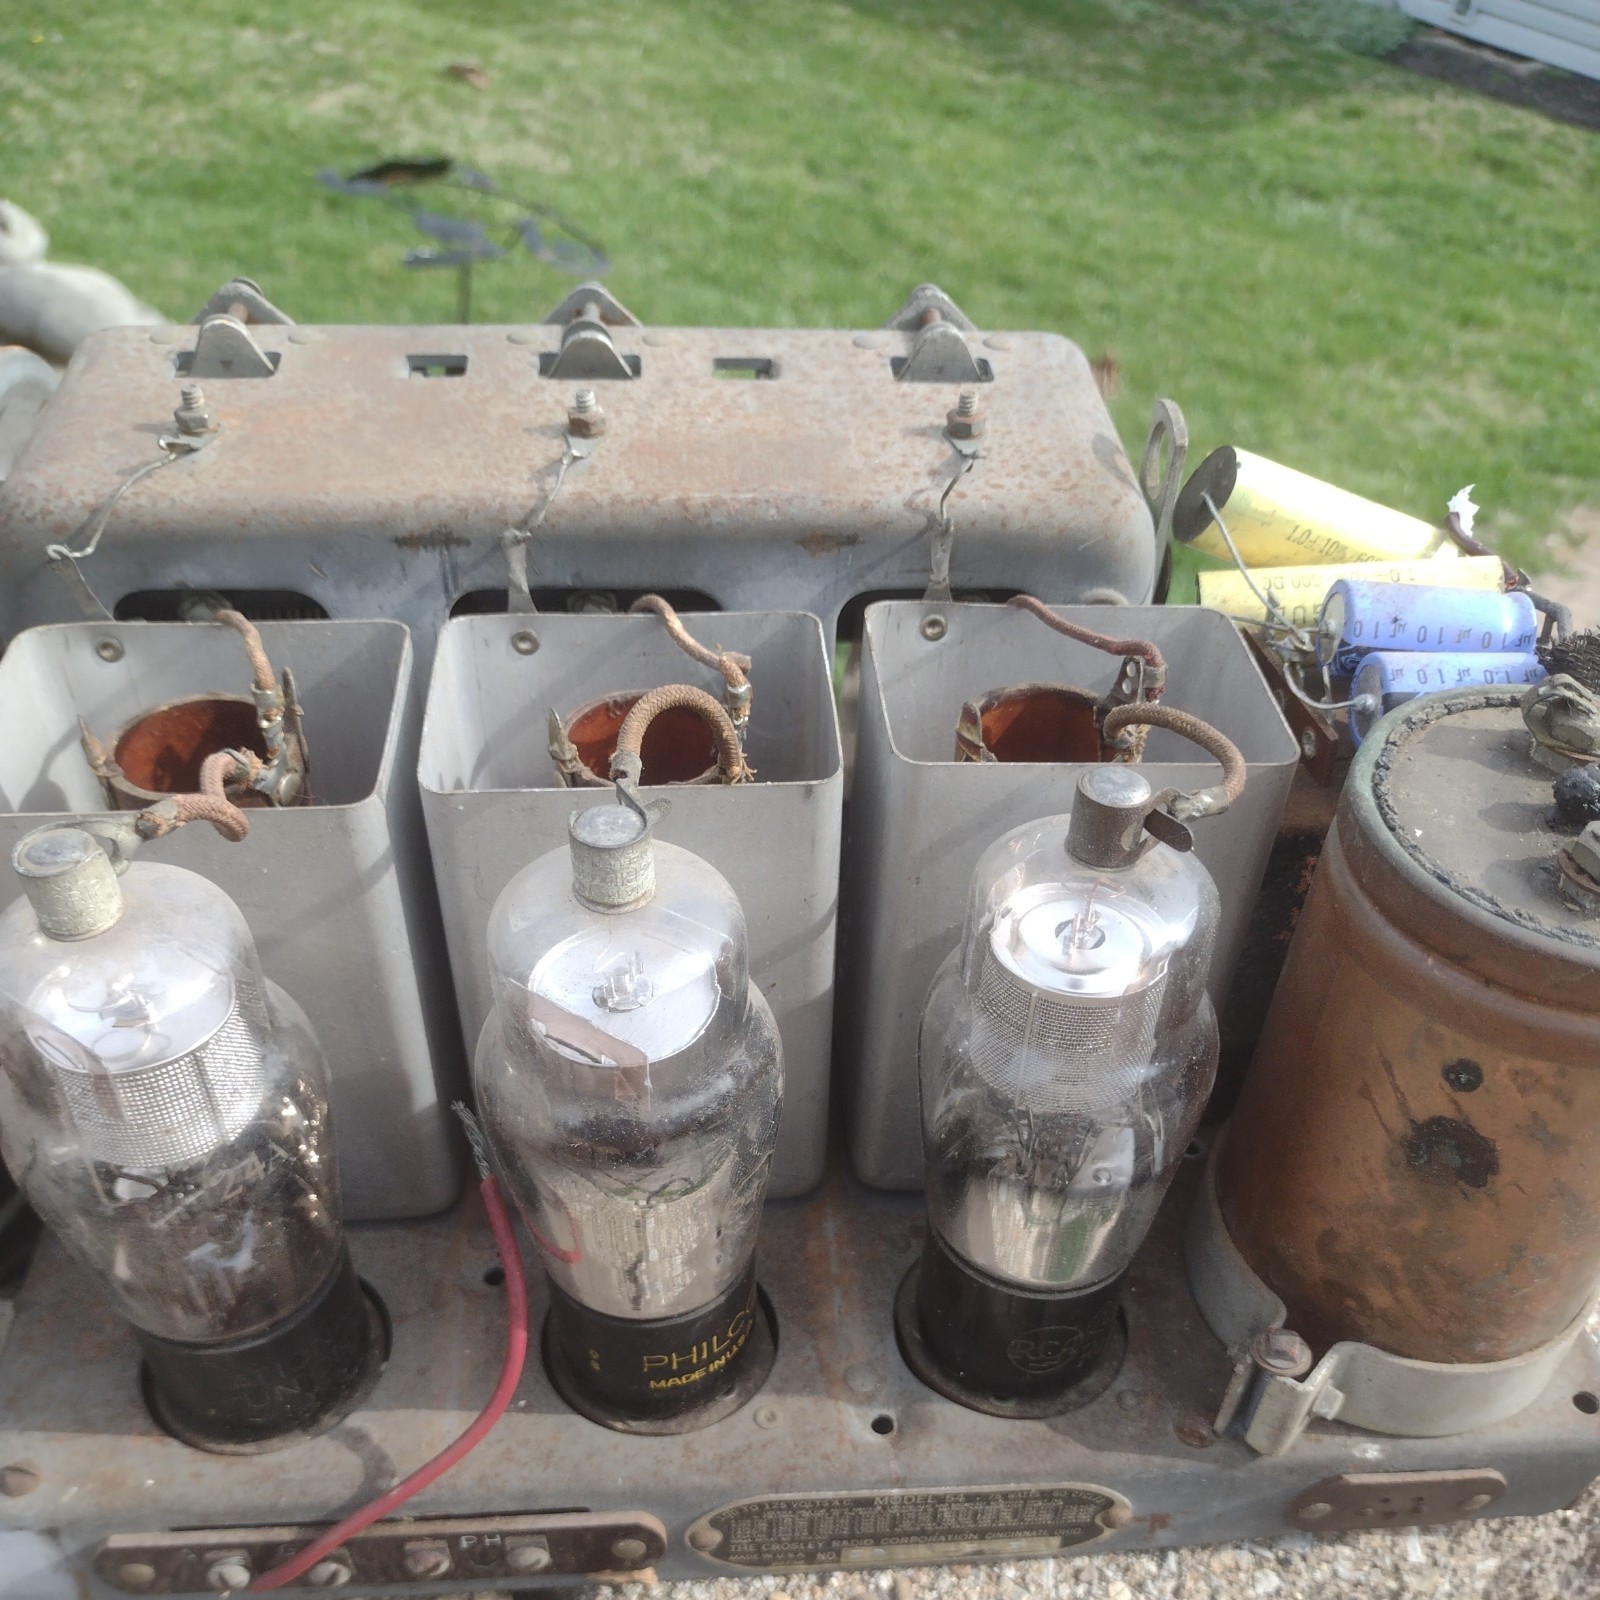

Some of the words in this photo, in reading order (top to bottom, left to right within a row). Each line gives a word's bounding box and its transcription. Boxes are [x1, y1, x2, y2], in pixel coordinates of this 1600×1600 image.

[649, 1366, 707, 1390] MADE
[873, 1493, 938, 1506] MODEL
[728, 1543, 758, 1553] THE
[761, 1541, 825, 1552] CROSLEY
[831, 1537, 875, 1549] RADIO
[880, 1532, 980, 1546] CORPORATION
